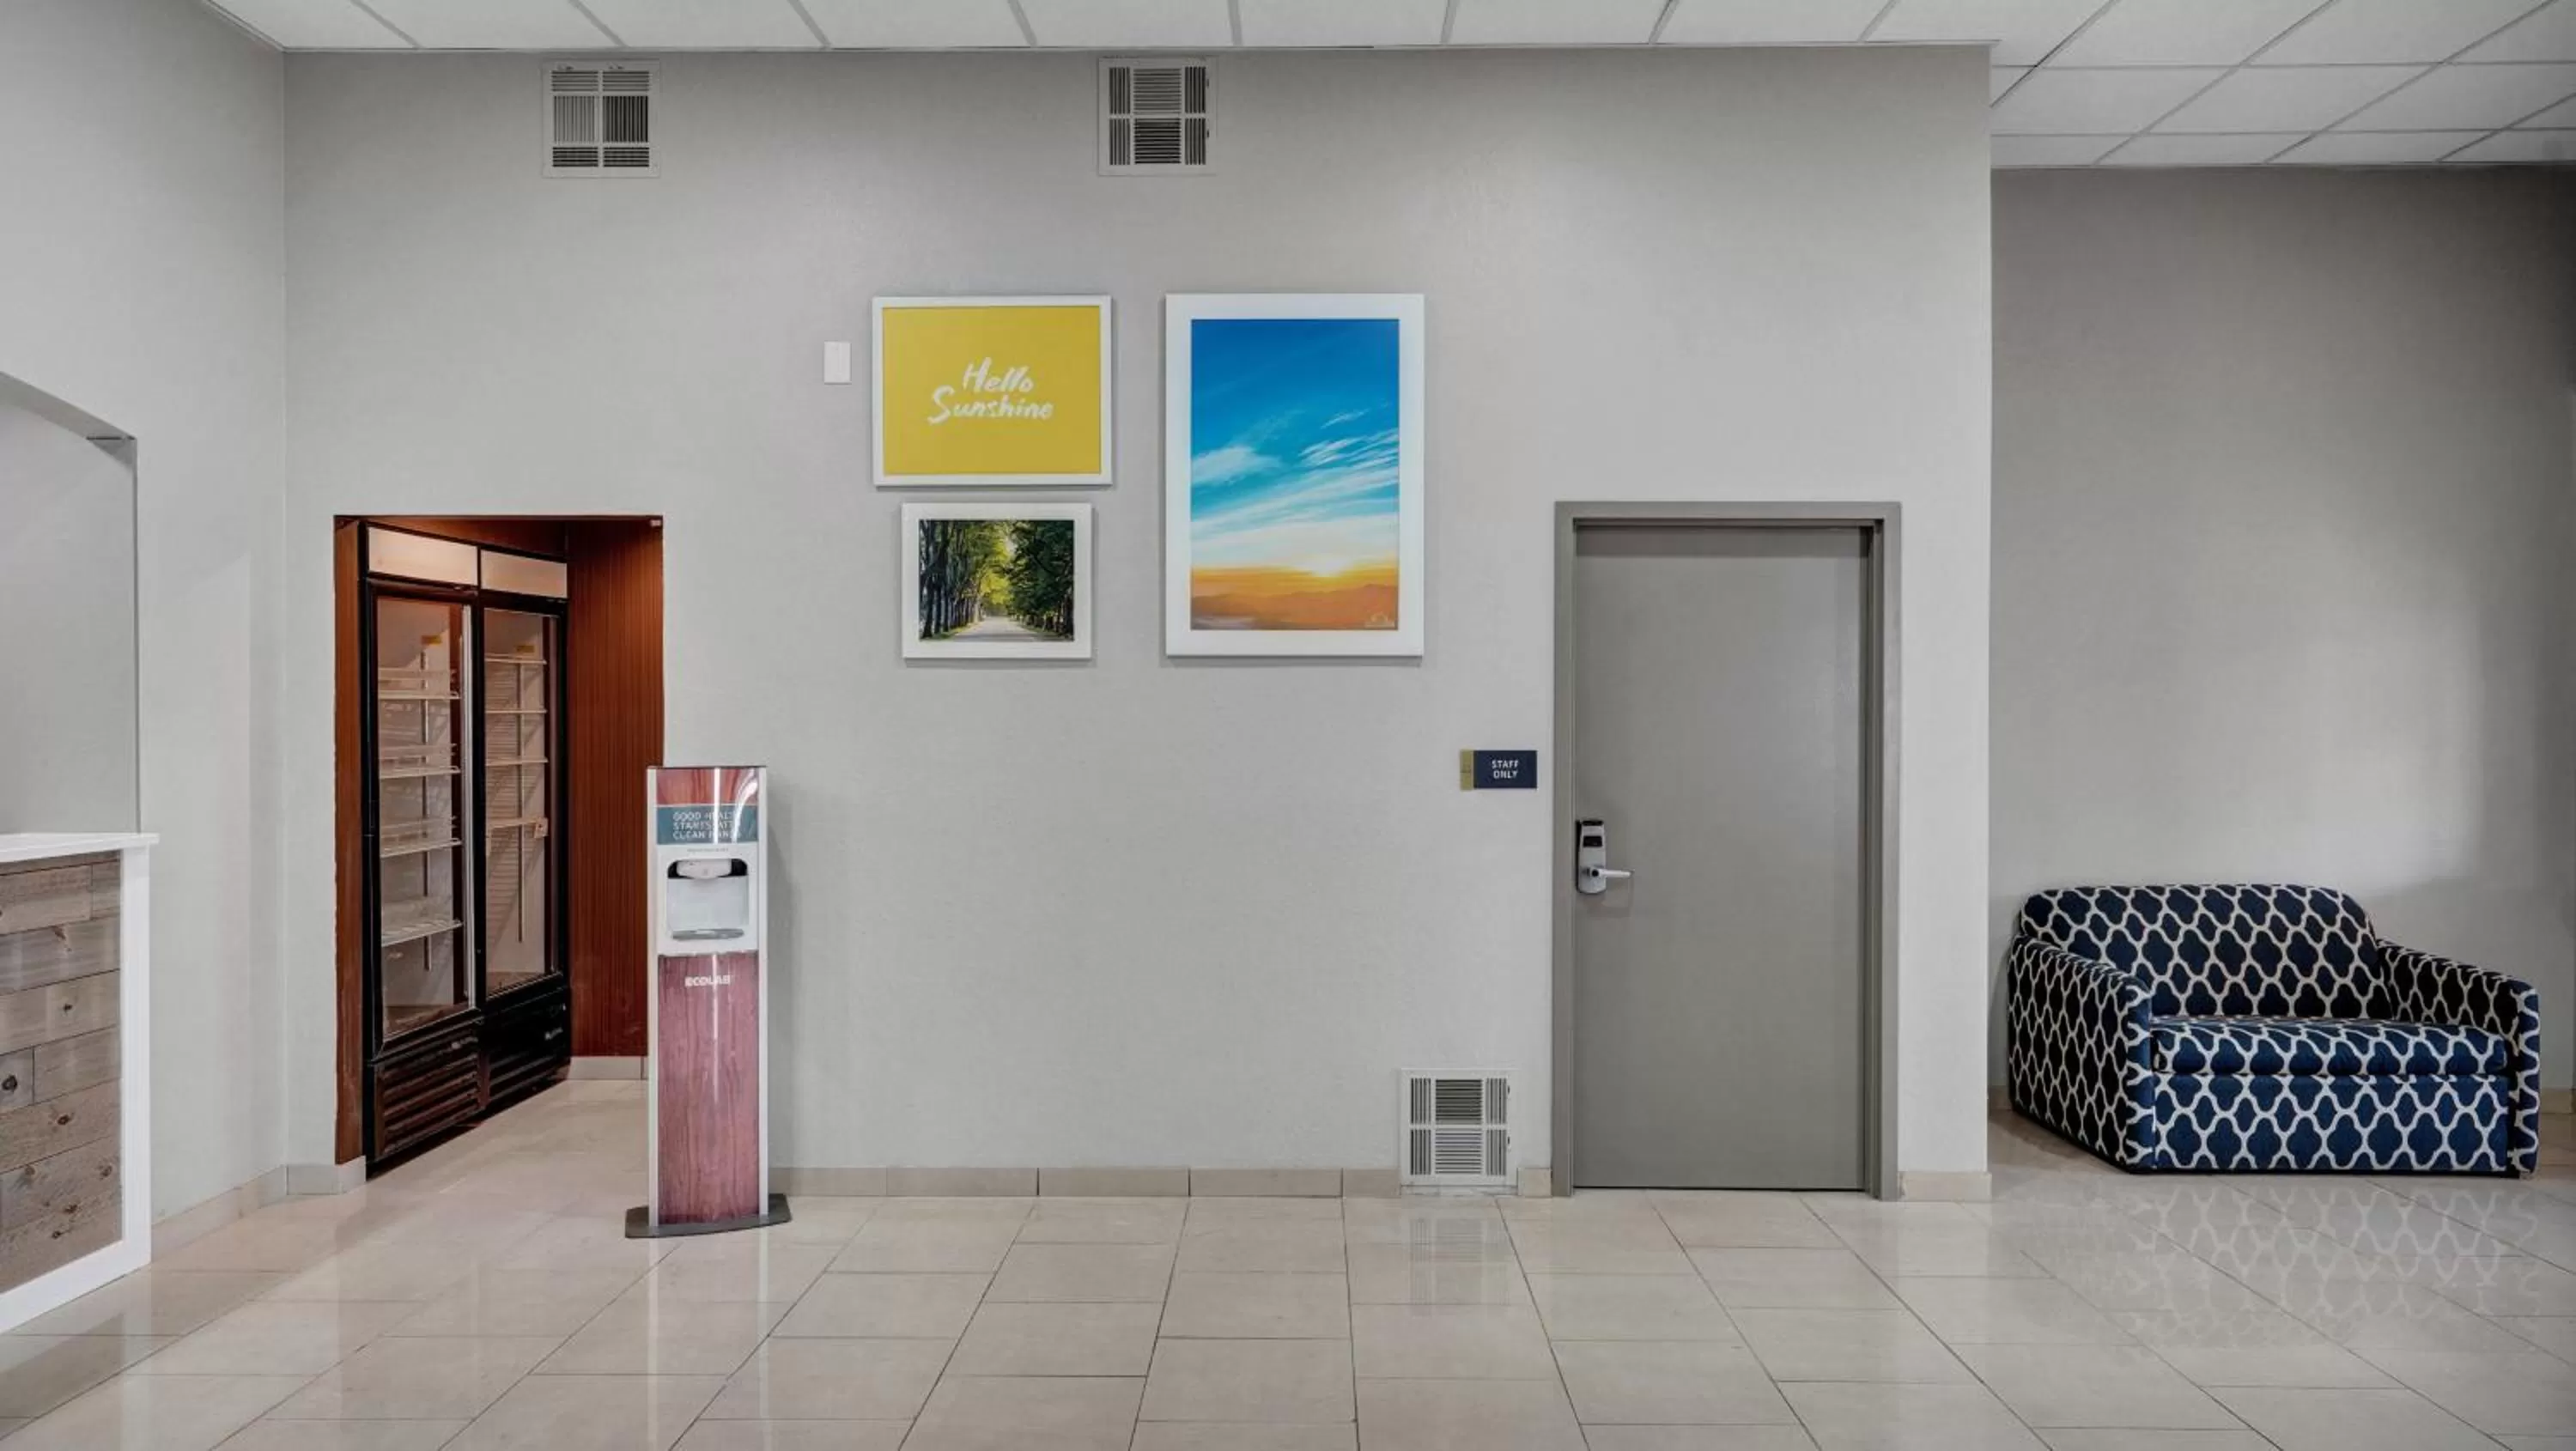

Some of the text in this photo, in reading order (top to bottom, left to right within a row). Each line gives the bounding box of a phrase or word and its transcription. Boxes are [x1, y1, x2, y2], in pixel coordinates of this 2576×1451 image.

[962, 356, 1035, 393] Hello
[927, 385, 1054, 426] Sunshine
[1492, 759, 1519, 769] STAFF
[1493, 769, 1517, 780] ONLY
[672, 811, 702, 822] GOOD
[672, 830, 705, 841] CLEAN
[684, 975, 731, 987] ECOLAB
